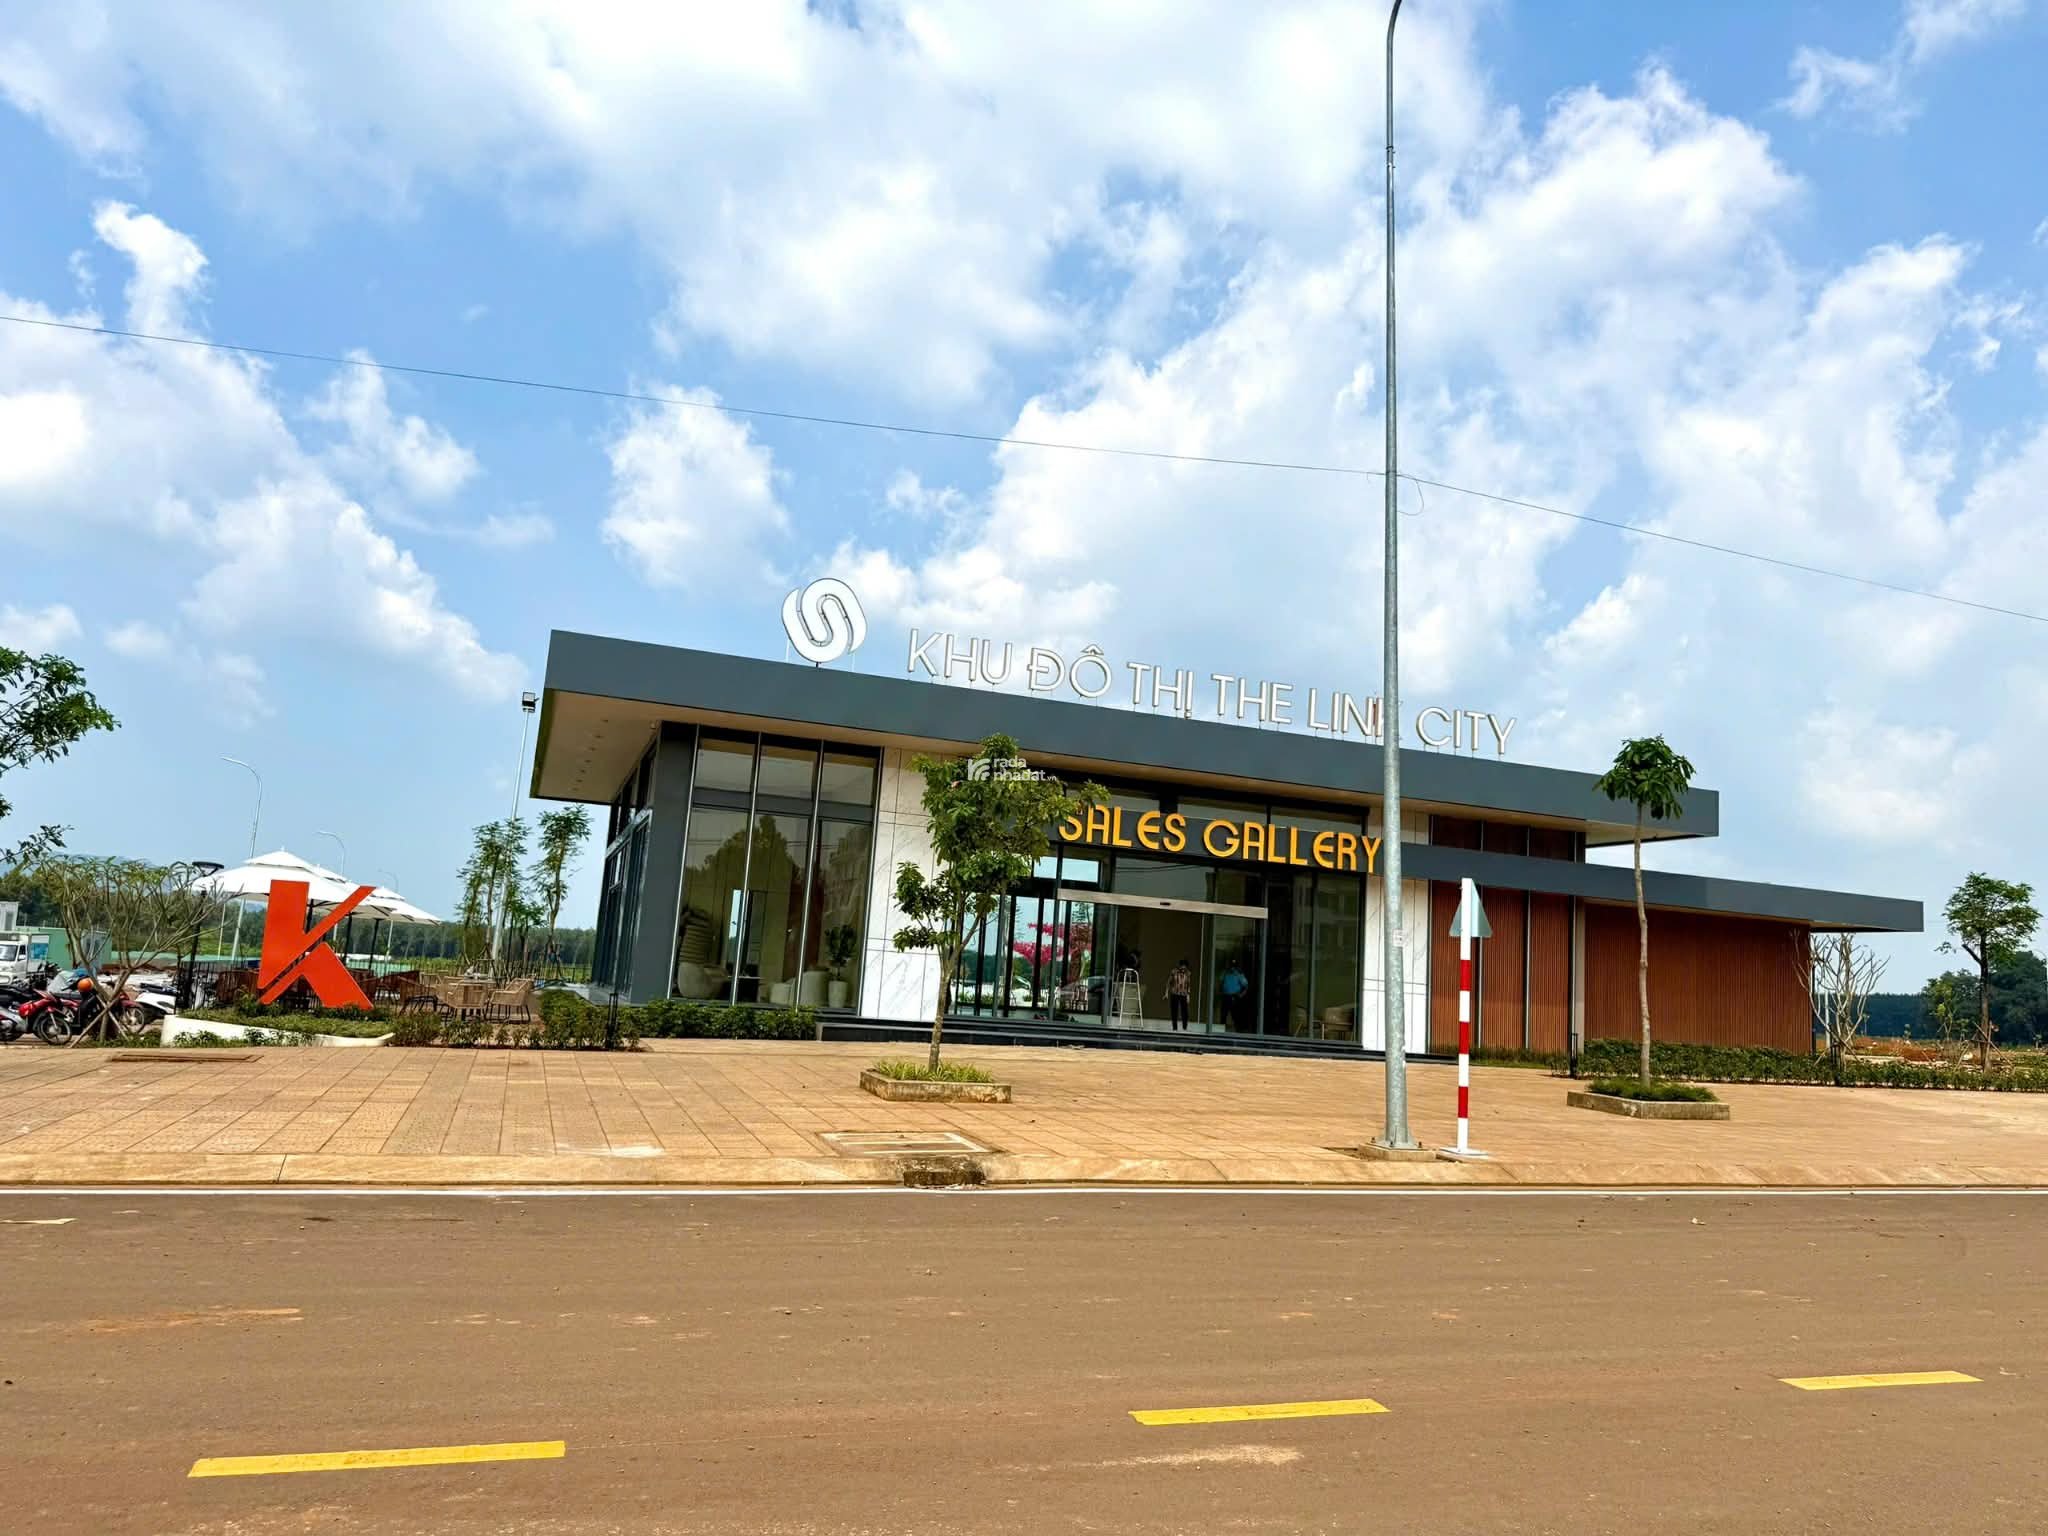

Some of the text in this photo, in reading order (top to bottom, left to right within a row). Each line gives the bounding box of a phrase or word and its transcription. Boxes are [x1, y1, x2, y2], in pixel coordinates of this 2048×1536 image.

[907, 628, 1013, 684] KHU
[1027, 643, 1112, 698] ĐÔ
[1127, 662, 1194, 719] THỊ
[1210, 673, 1293, 725] THE
[1416, 706, 1517, 755] CITY
[1203, 818, 1384, 873] GALLERY
